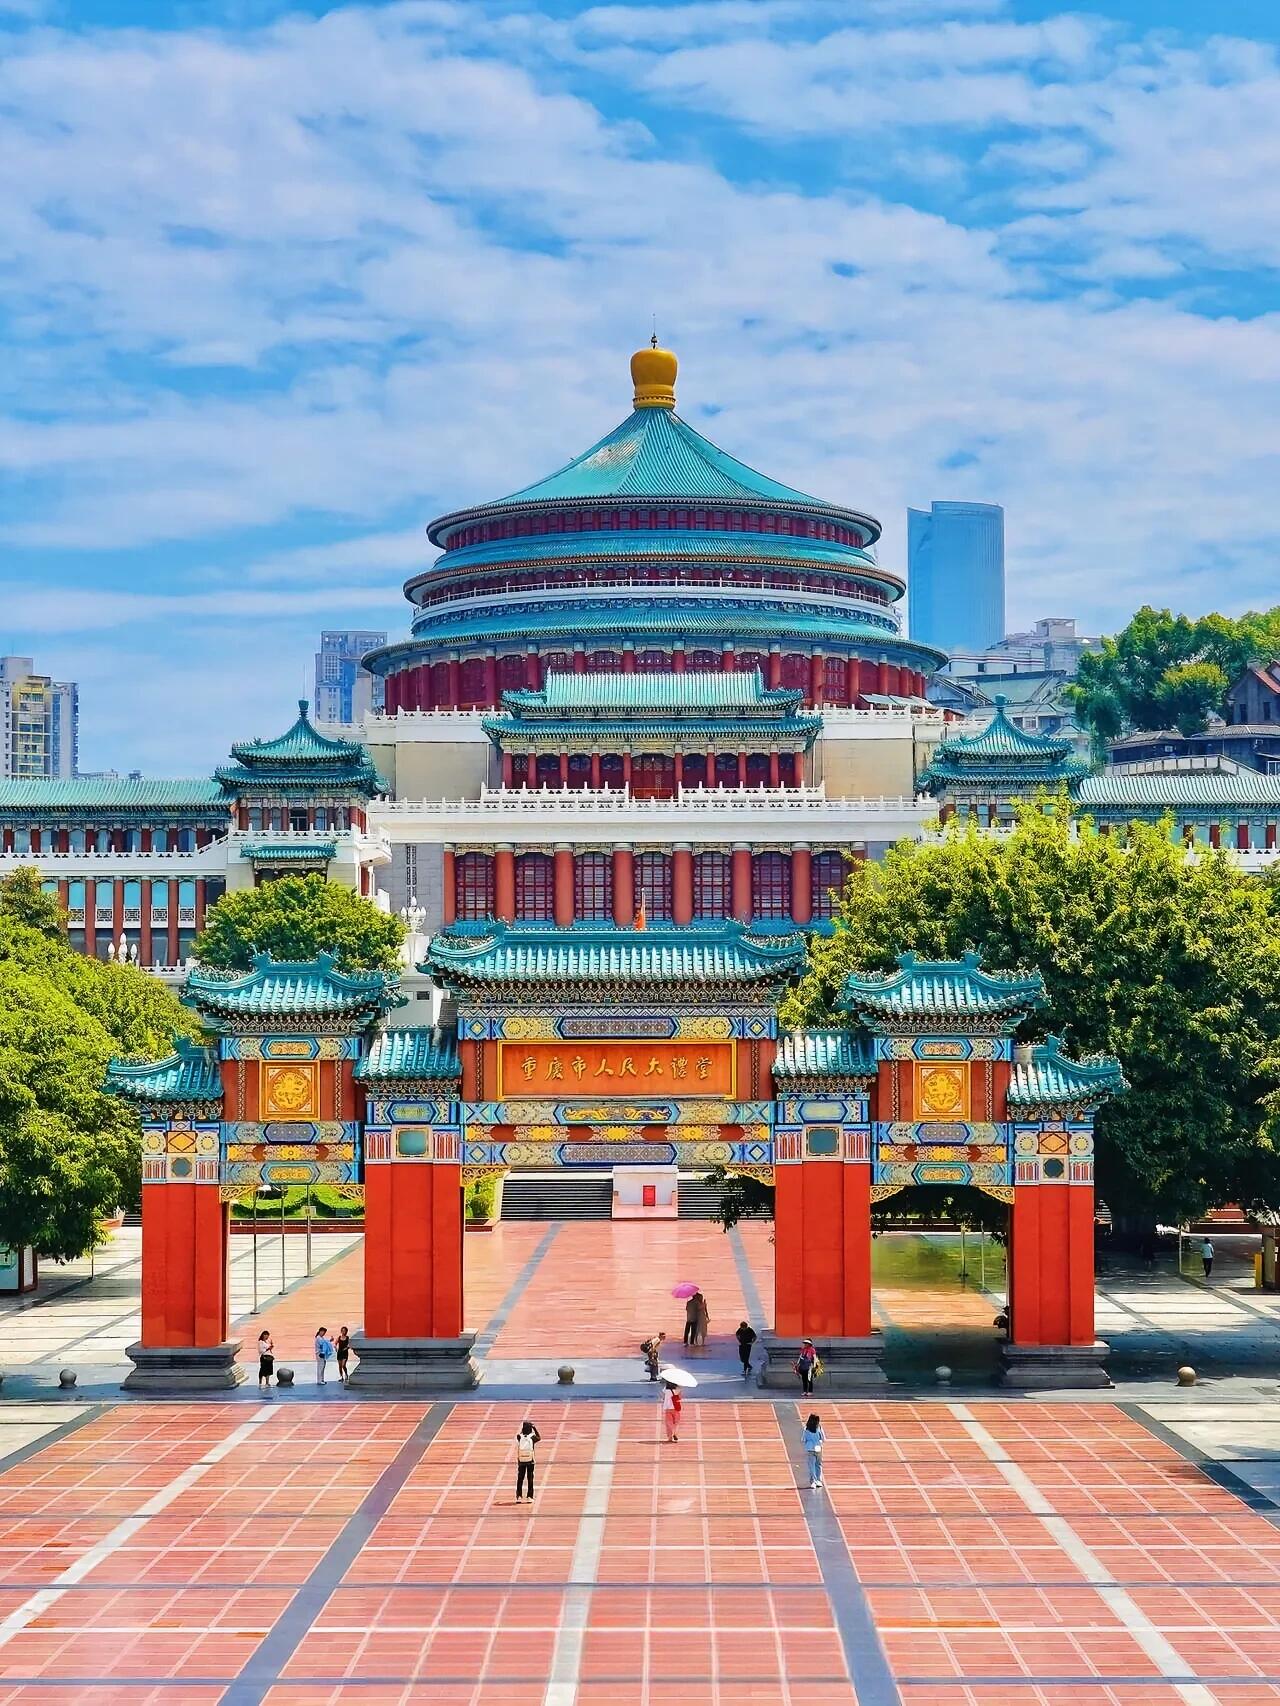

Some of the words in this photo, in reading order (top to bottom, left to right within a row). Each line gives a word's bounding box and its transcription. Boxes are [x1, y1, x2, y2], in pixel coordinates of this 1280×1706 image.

[521, 1055, 713, 1081] 重慶市人民大禮堂
